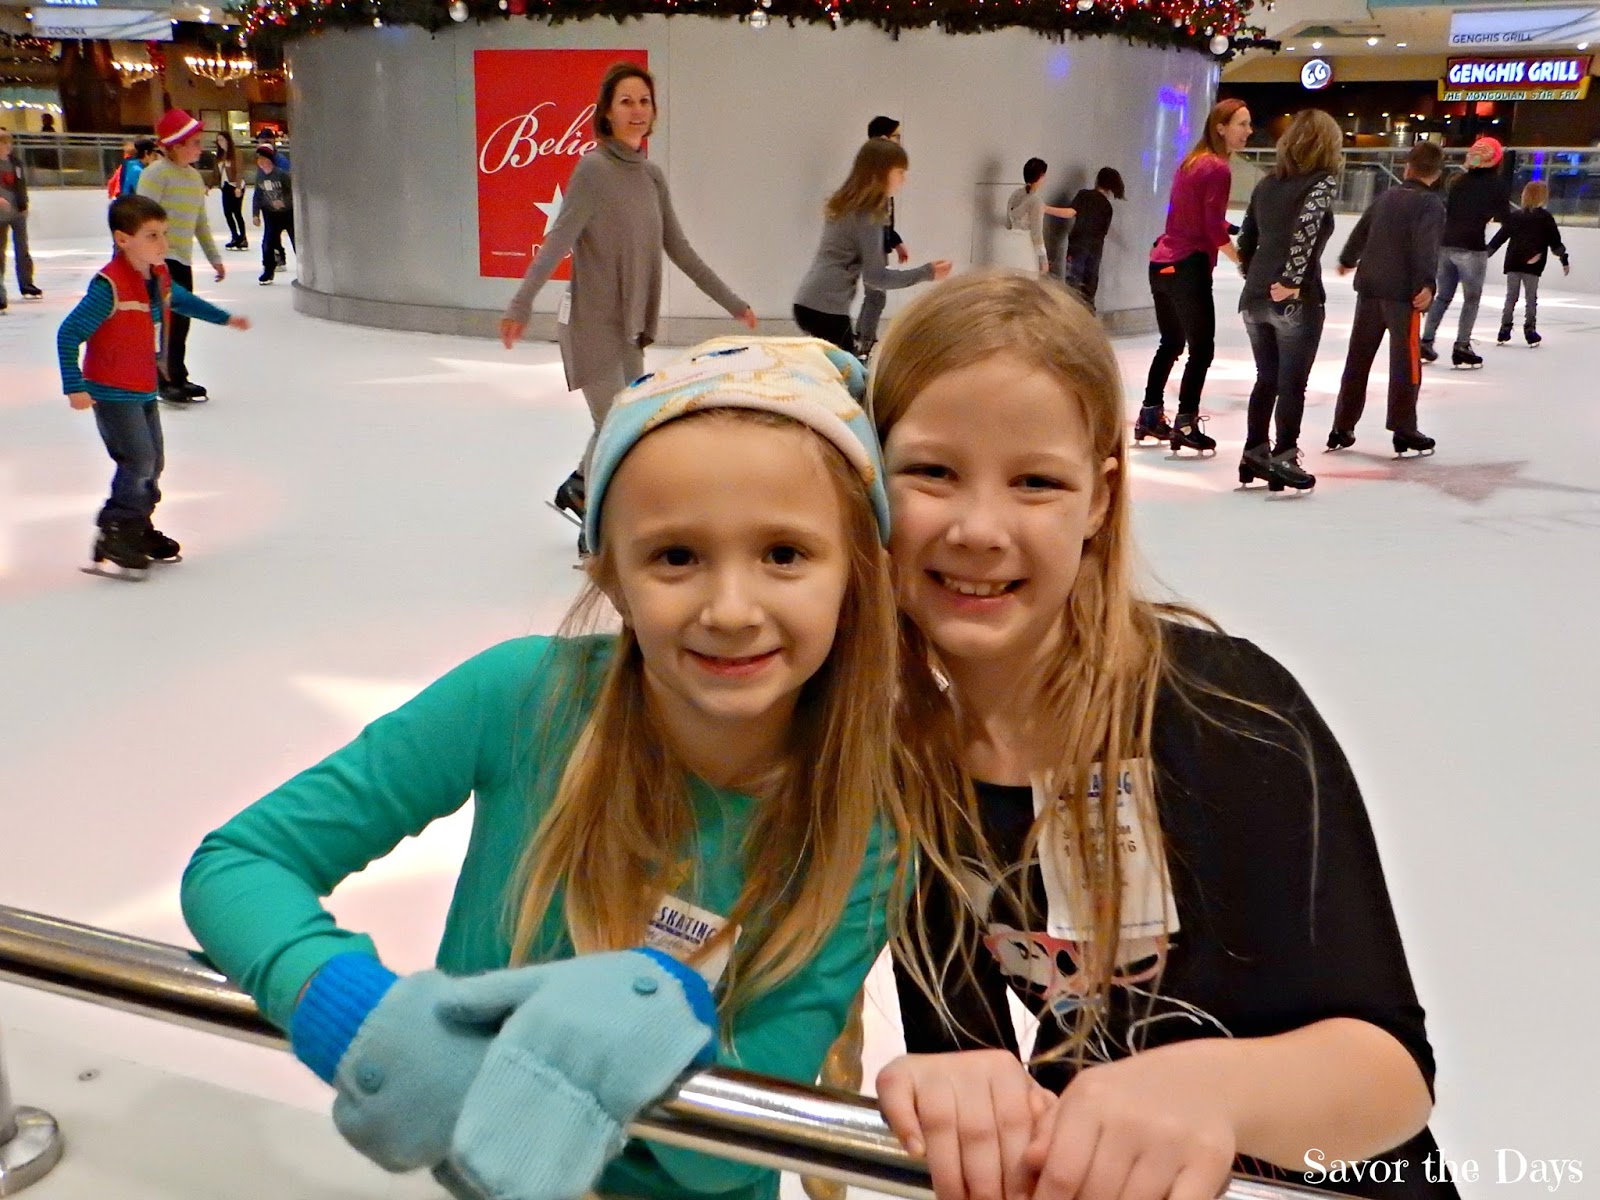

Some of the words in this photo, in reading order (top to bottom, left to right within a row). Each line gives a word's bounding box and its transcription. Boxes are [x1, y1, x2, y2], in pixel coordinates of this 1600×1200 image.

[1452, 33, 1500, 44] GENGHIS
[1502, 32, 1533, 43] GRILL
[1449, 61, 1526, 84] GENGHIS
[1527, 60, 1580, 83] GRILL
[1443, 91, 1463, 101] THE
[1465, 91, 1526, 101] MONGOLIAN
[1559, 91, 1580, 100] FRY
[479, 101, 599, 175] Belie
